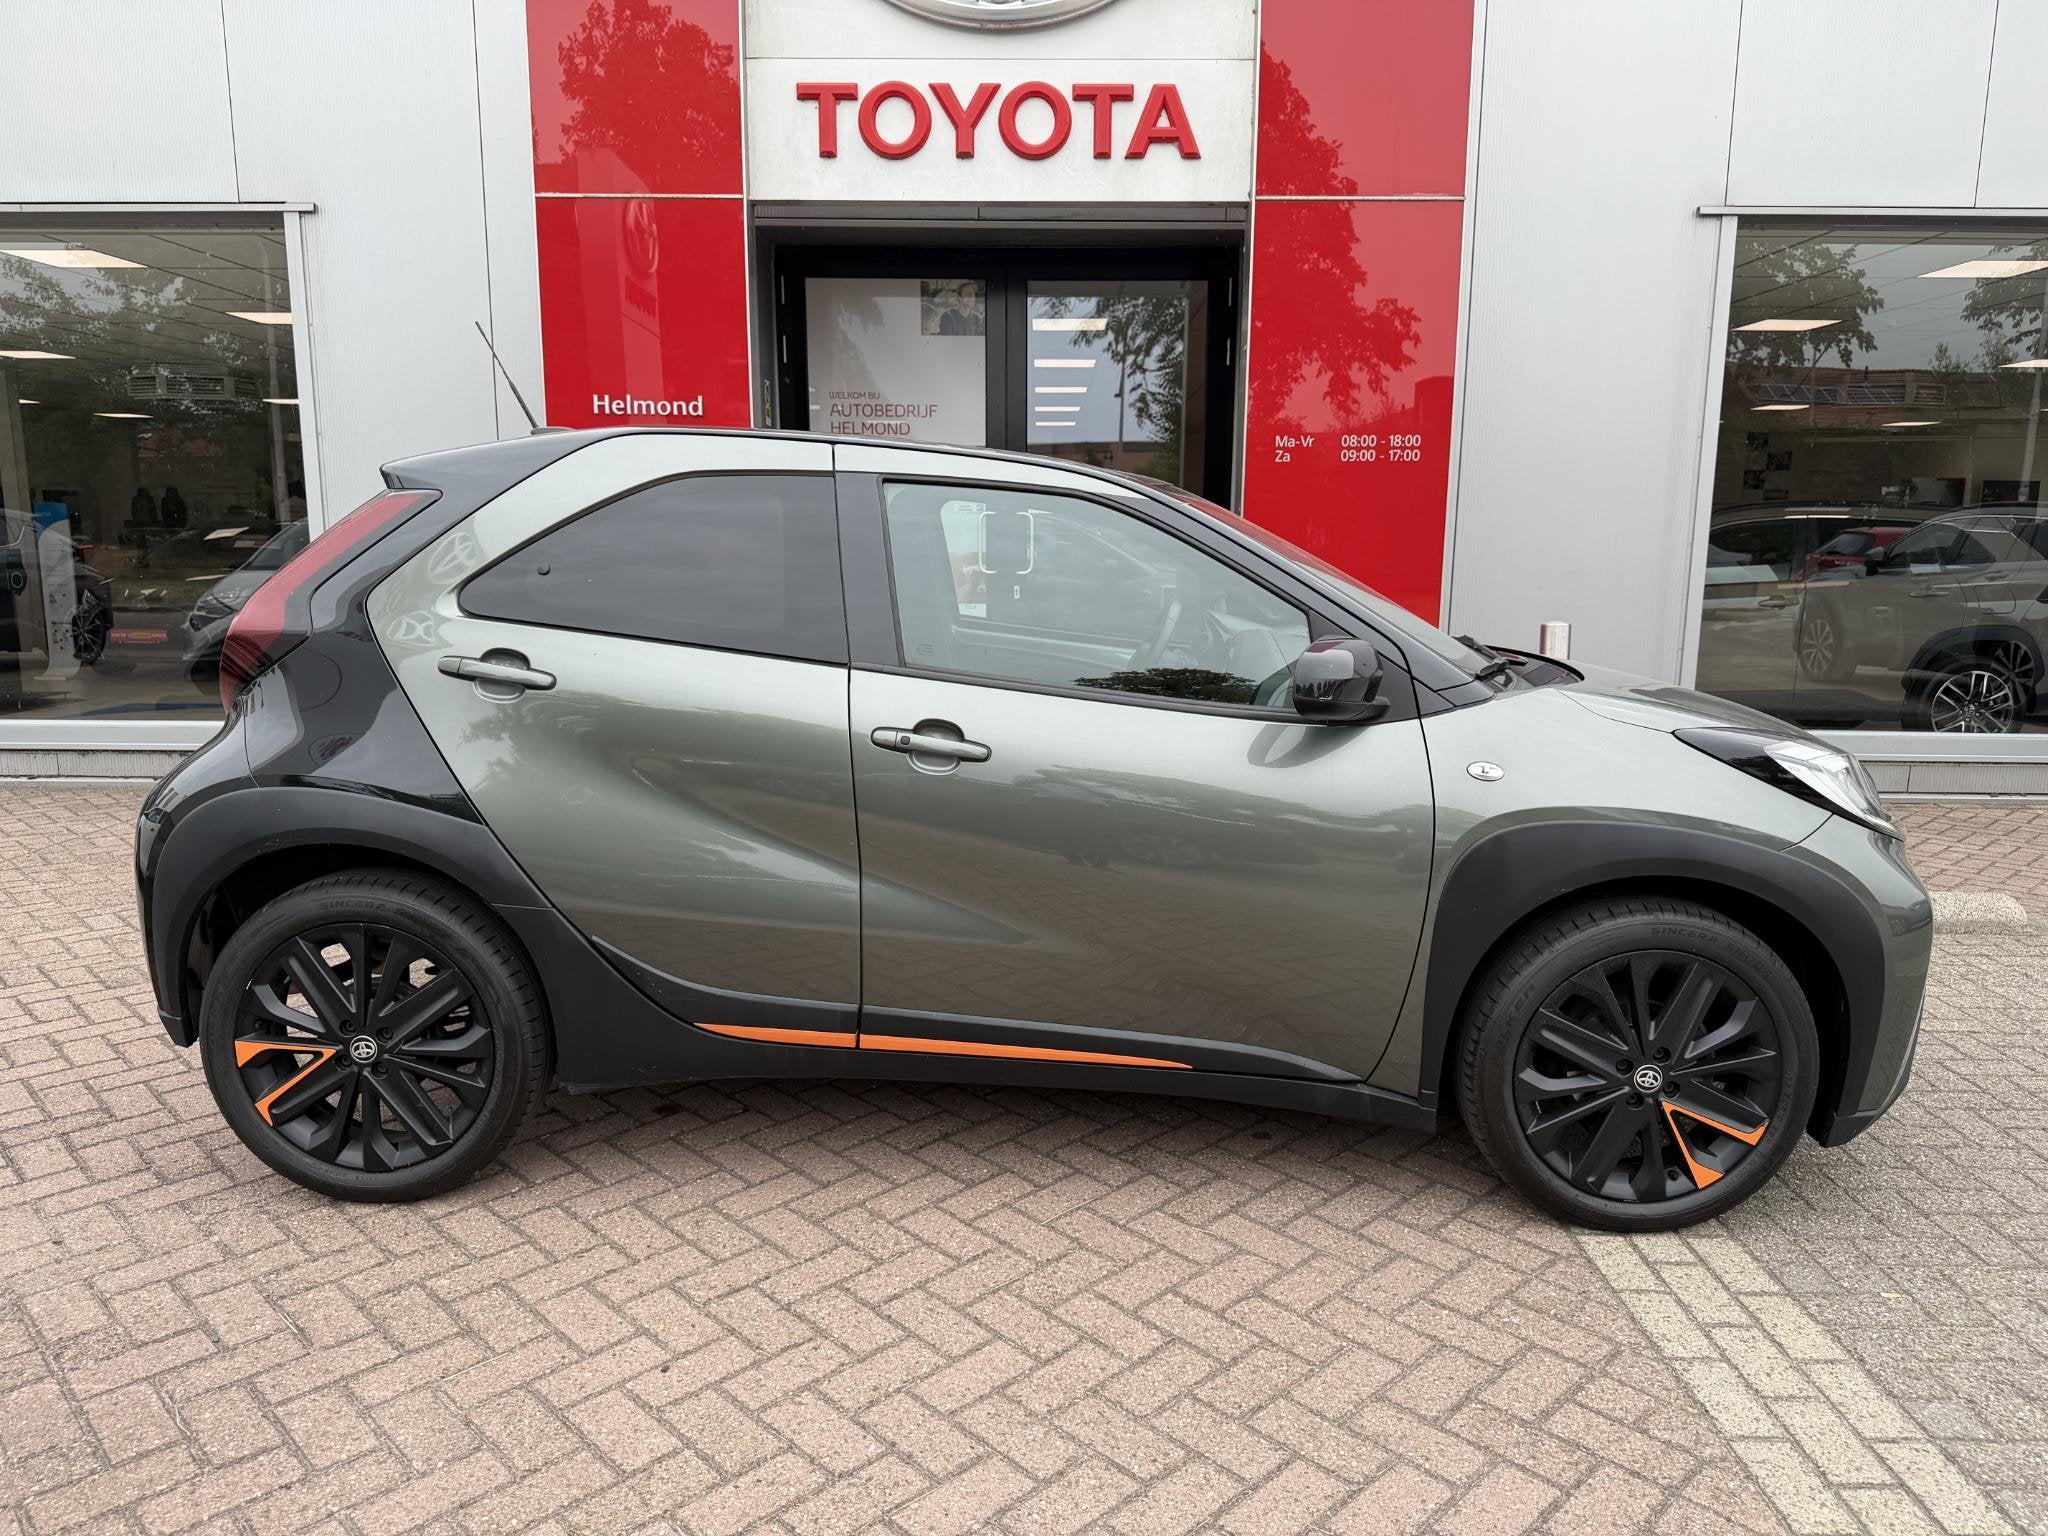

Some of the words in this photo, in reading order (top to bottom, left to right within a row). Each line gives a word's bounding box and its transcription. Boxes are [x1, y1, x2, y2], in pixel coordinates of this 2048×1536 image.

[796, 80, 1202, 161] TOYOTA
[829, 391, 867, 400] WELKOM
[868, 392, 880, 400] BIJ
[592, 393, 704, 416] Helmond
[830, 403, 938, 418] AUTOBEDRIJF
[830, 421, 911, 436] HELMOND
[1275, 435, 1315, 448] Ma-Vr
[1341, 434, 1377, 447] 08:00
[1388, 434, 1421, 447] 18:00
[1274, 450, 1291, 463] Za
[1340, 449, 1376, 462] 09:00
[1388, 449, 1421, 462] 17:00
[319, 900, 386, 912] SINCERA
[1650, 927, 1718, 945] SINCERA
